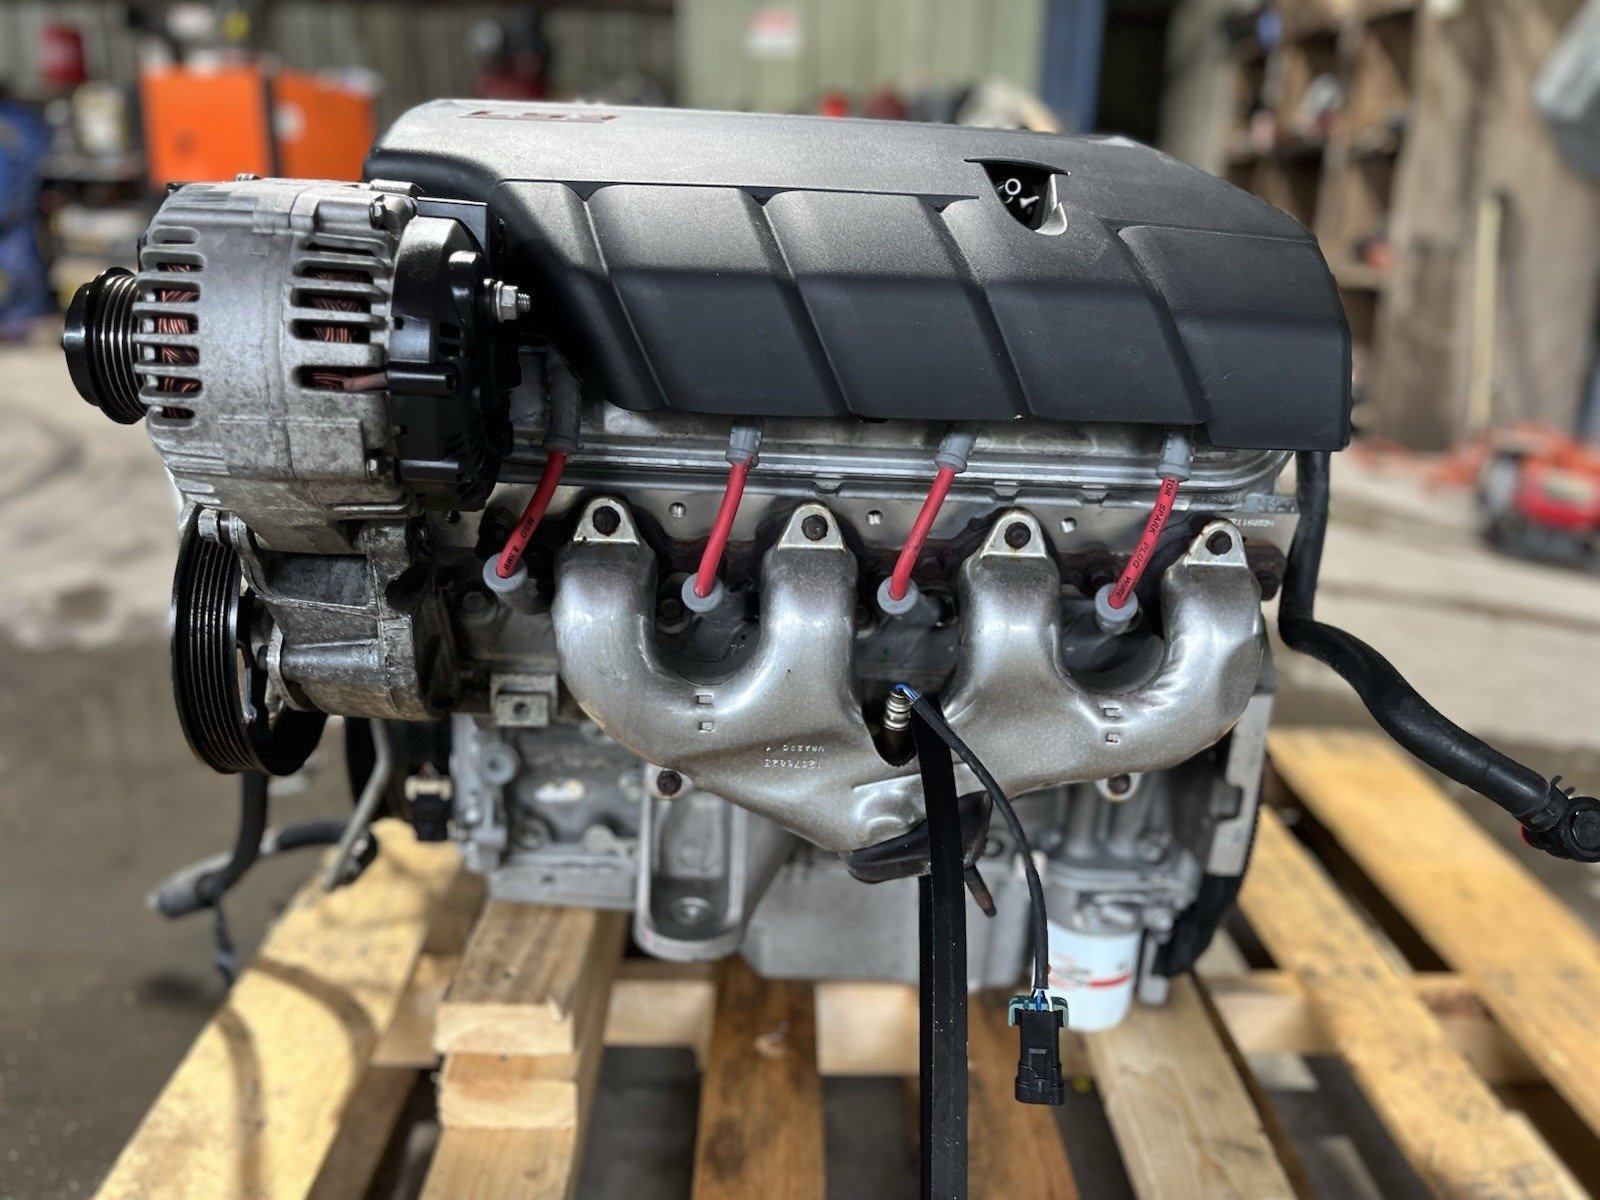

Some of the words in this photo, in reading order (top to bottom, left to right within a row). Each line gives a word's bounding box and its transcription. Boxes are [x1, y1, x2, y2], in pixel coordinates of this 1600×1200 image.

[1163, 478, 1175, 497] TOR
[520, 516, 536, 539] MSD
[1148, 504, 1167, 536] SPARK
[1133, 541, 1150, 570] PLUG
[1116, 576, 1131, 599] WIRE
